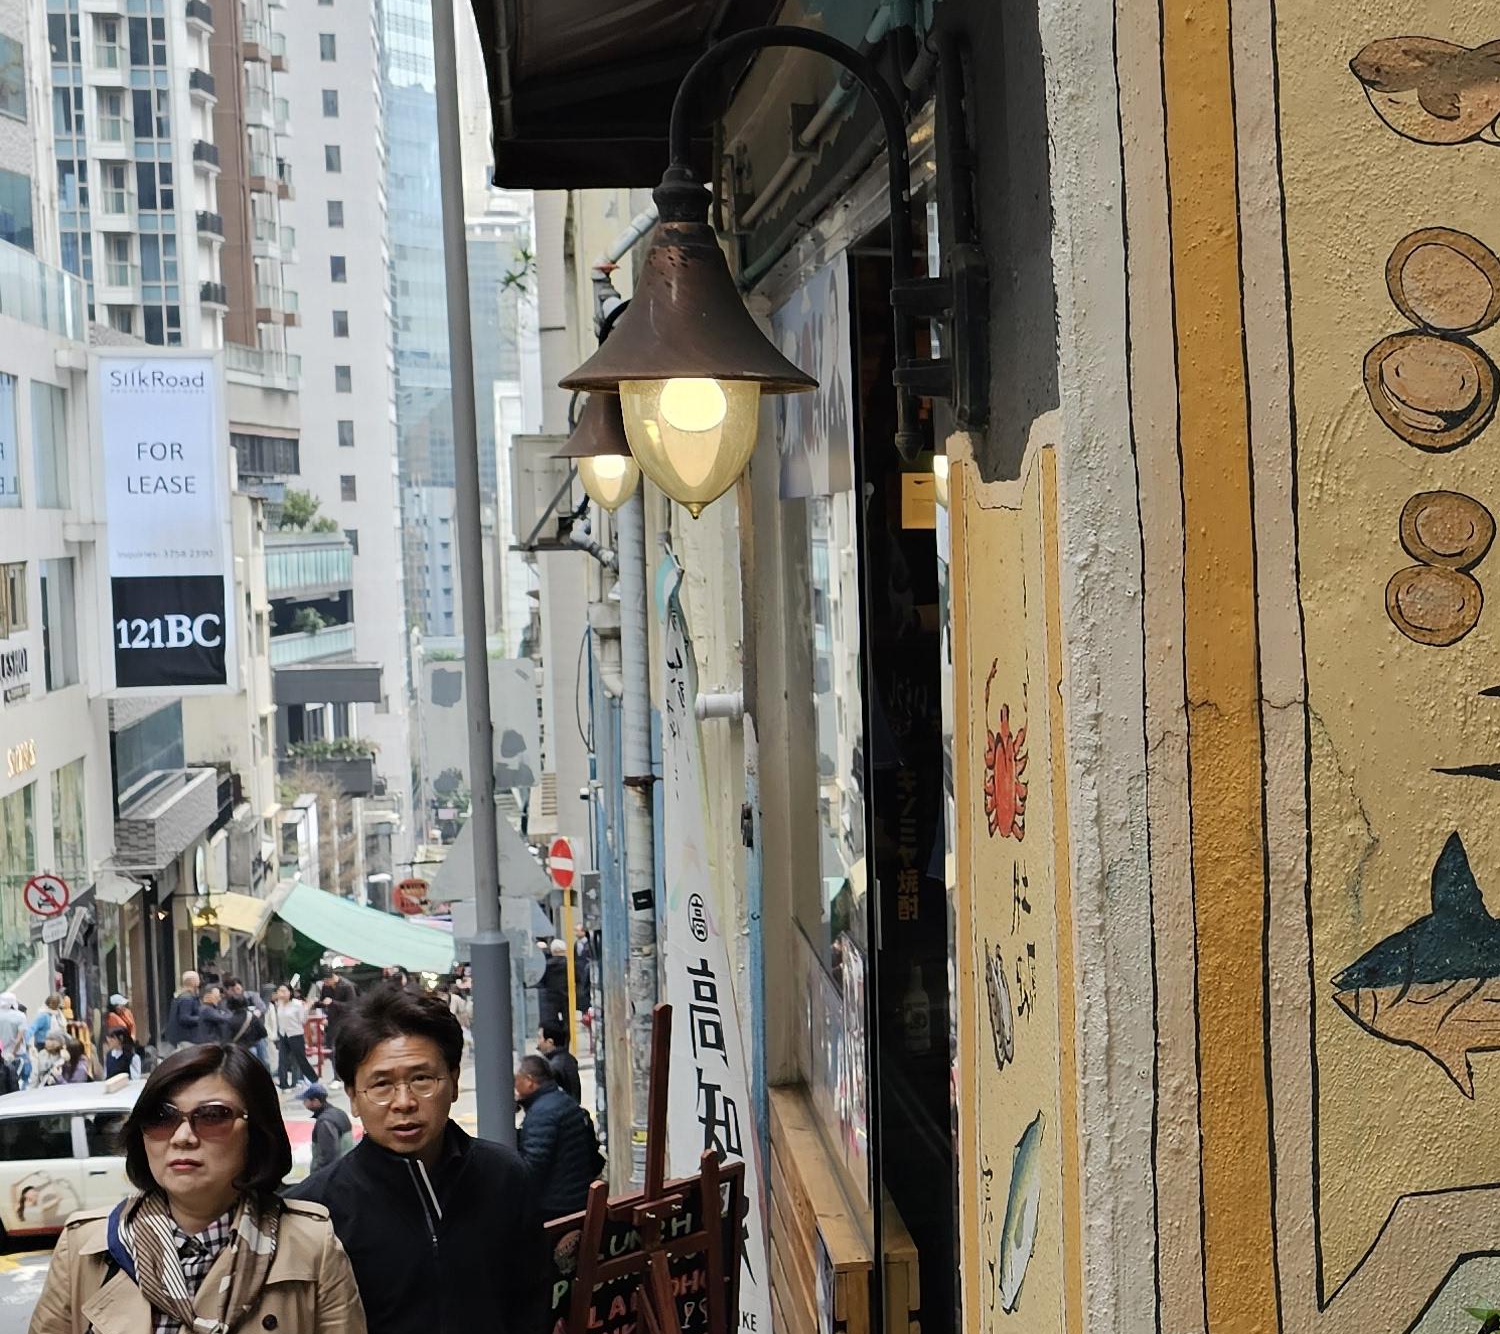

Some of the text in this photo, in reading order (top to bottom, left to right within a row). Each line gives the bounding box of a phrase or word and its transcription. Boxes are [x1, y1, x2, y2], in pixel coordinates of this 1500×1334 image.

[110, 370, 205, 388] SilkRoad
[136, 442, 184, 462] FOR
[127, 475, 196, 495] LEASE
[116, 614, 222, 650] 121BC
